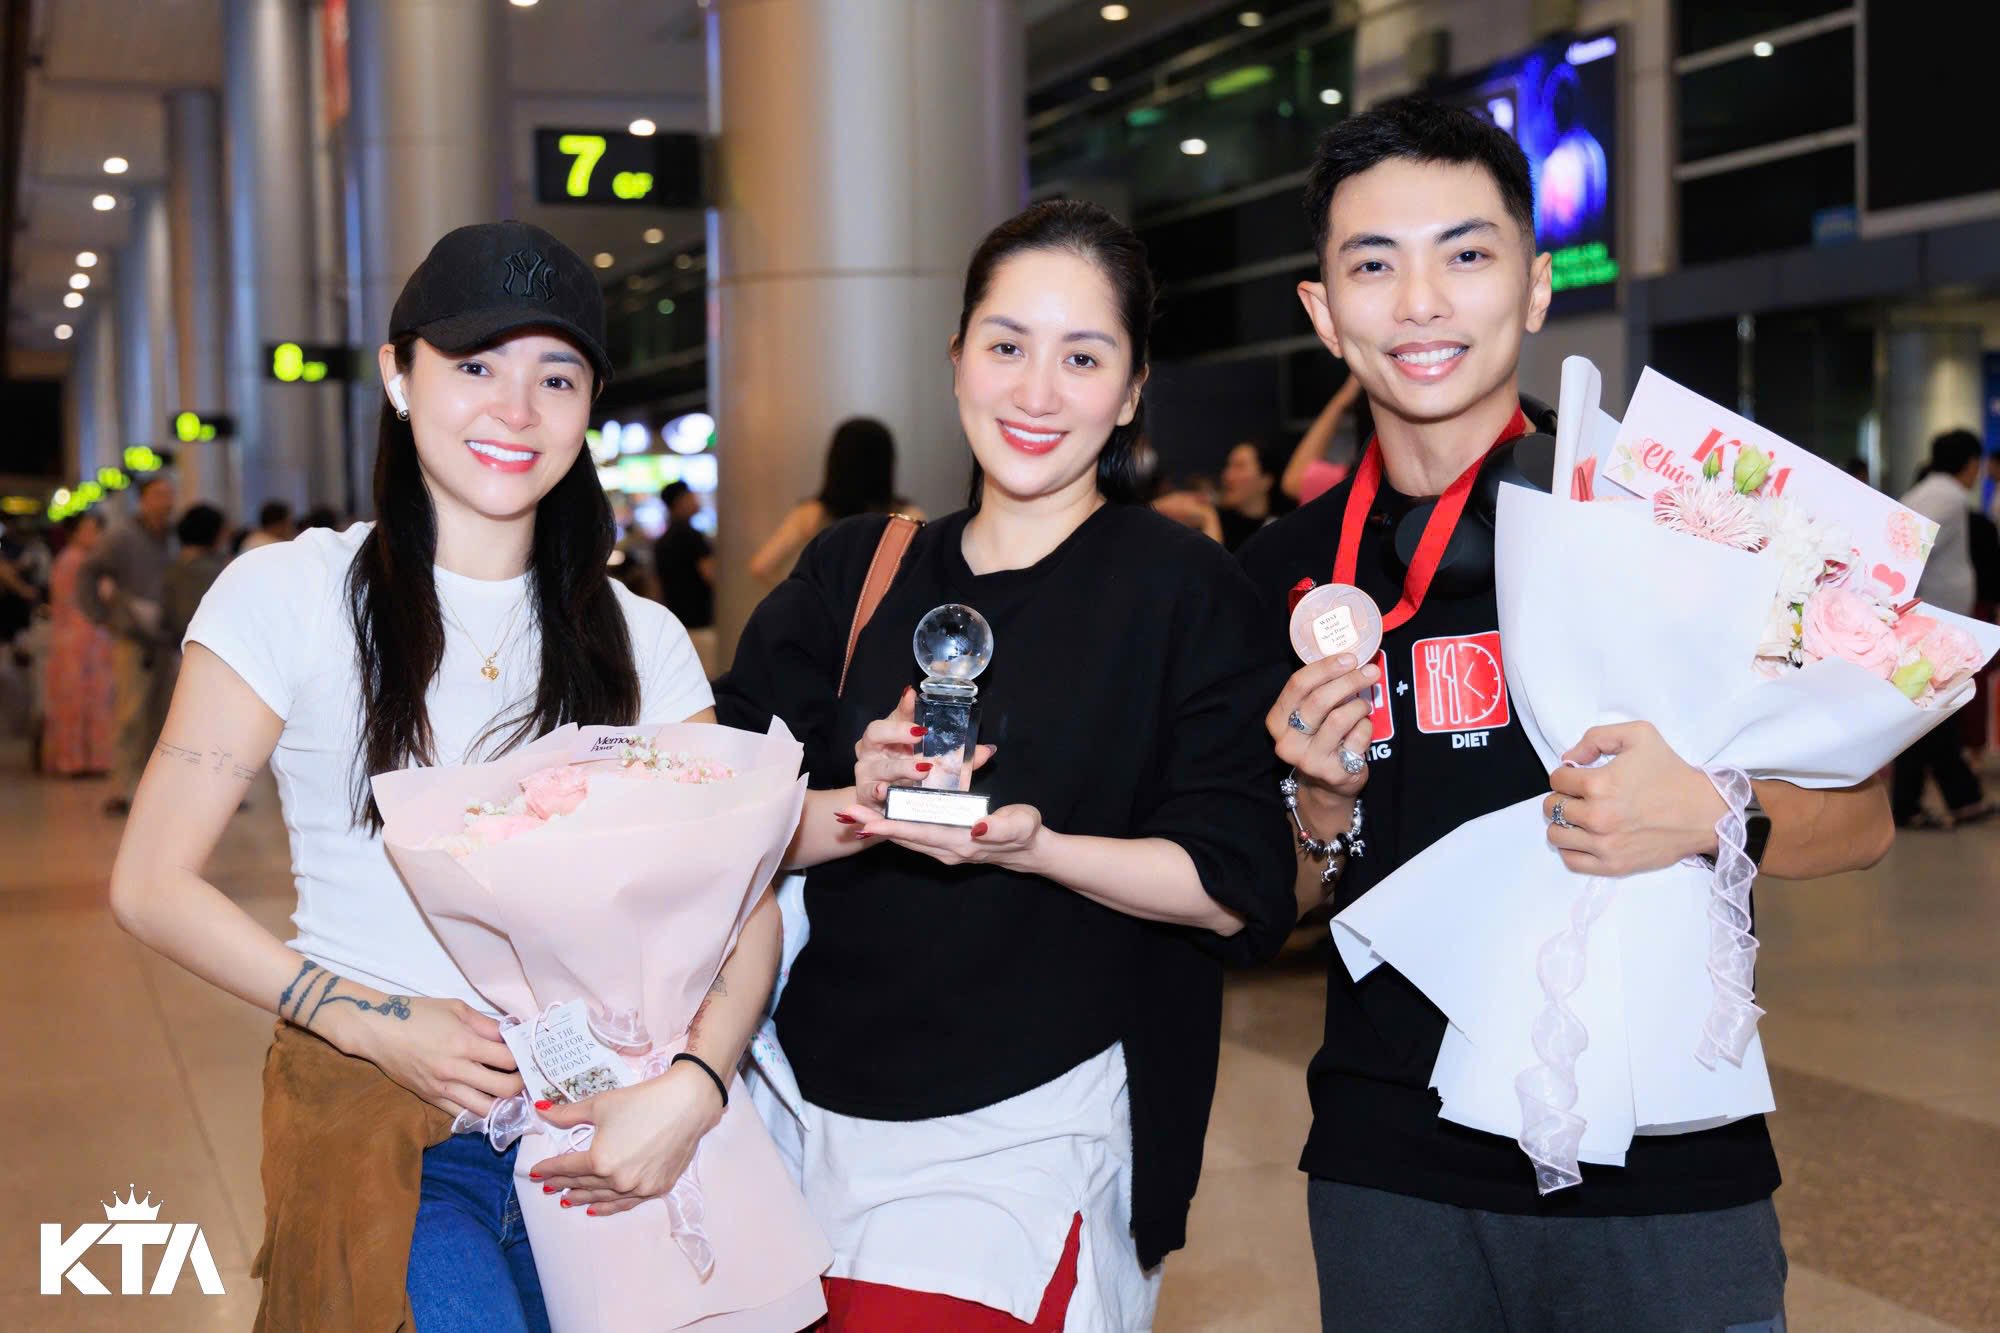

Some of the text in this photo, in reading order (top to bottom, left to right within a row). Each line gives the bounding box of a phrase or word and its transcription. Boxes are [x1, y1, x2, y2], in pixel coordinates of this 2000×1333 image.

[559, 134, 606, 197] 7
[1452, 731, 1490, 749] DIET
[556, 1026, 577, 1040] THE
[540, 1034, 585, 1058] OWER FOR
[560, 1046, 584, 1061] LOVE
[560, 1054, 592, 1073] HONEY
